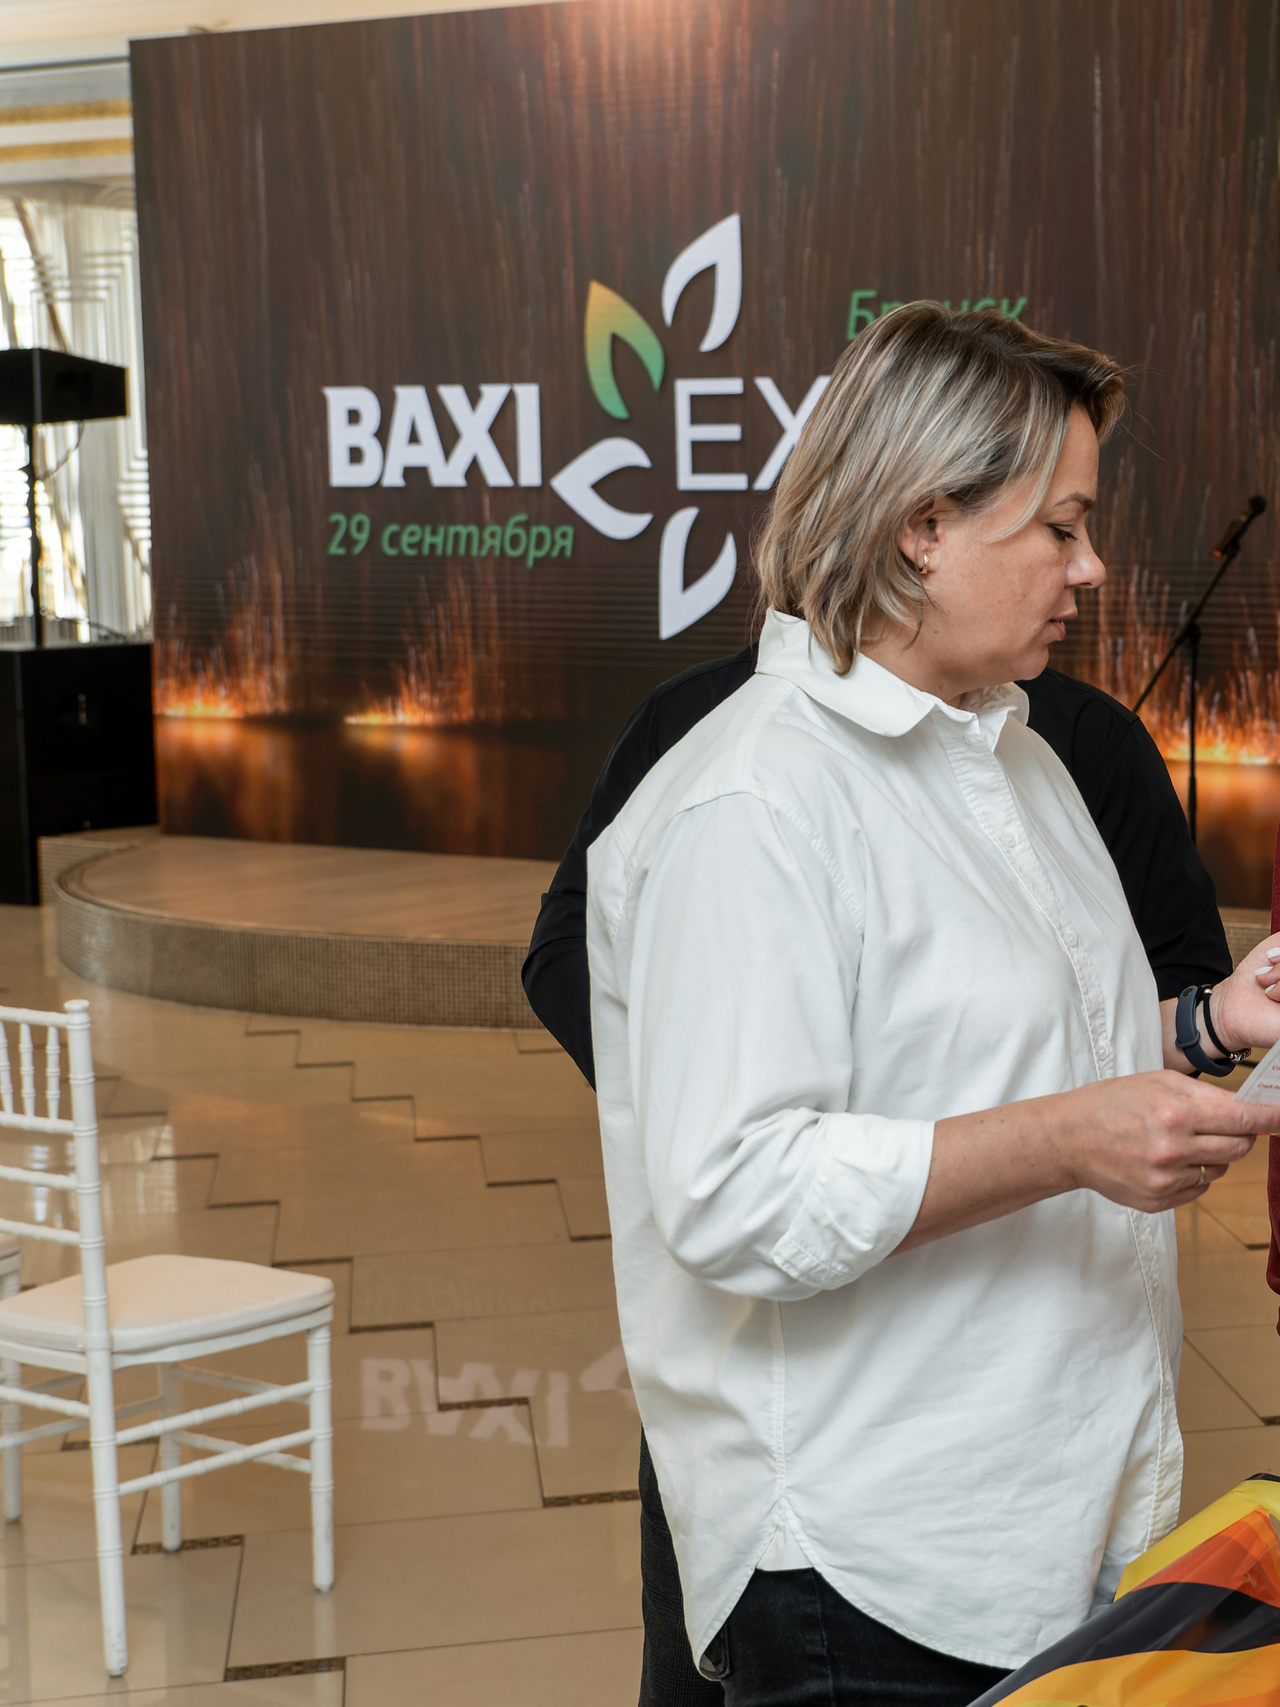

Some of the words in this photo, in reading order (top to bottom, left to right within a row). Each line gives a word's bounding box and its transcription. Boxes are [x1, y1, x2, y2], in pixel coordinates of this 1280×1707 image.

[324, 383, 541, 487] BAXI
[327, 512, 370, 556] 29
[382, 513, 574, 568] сентября
